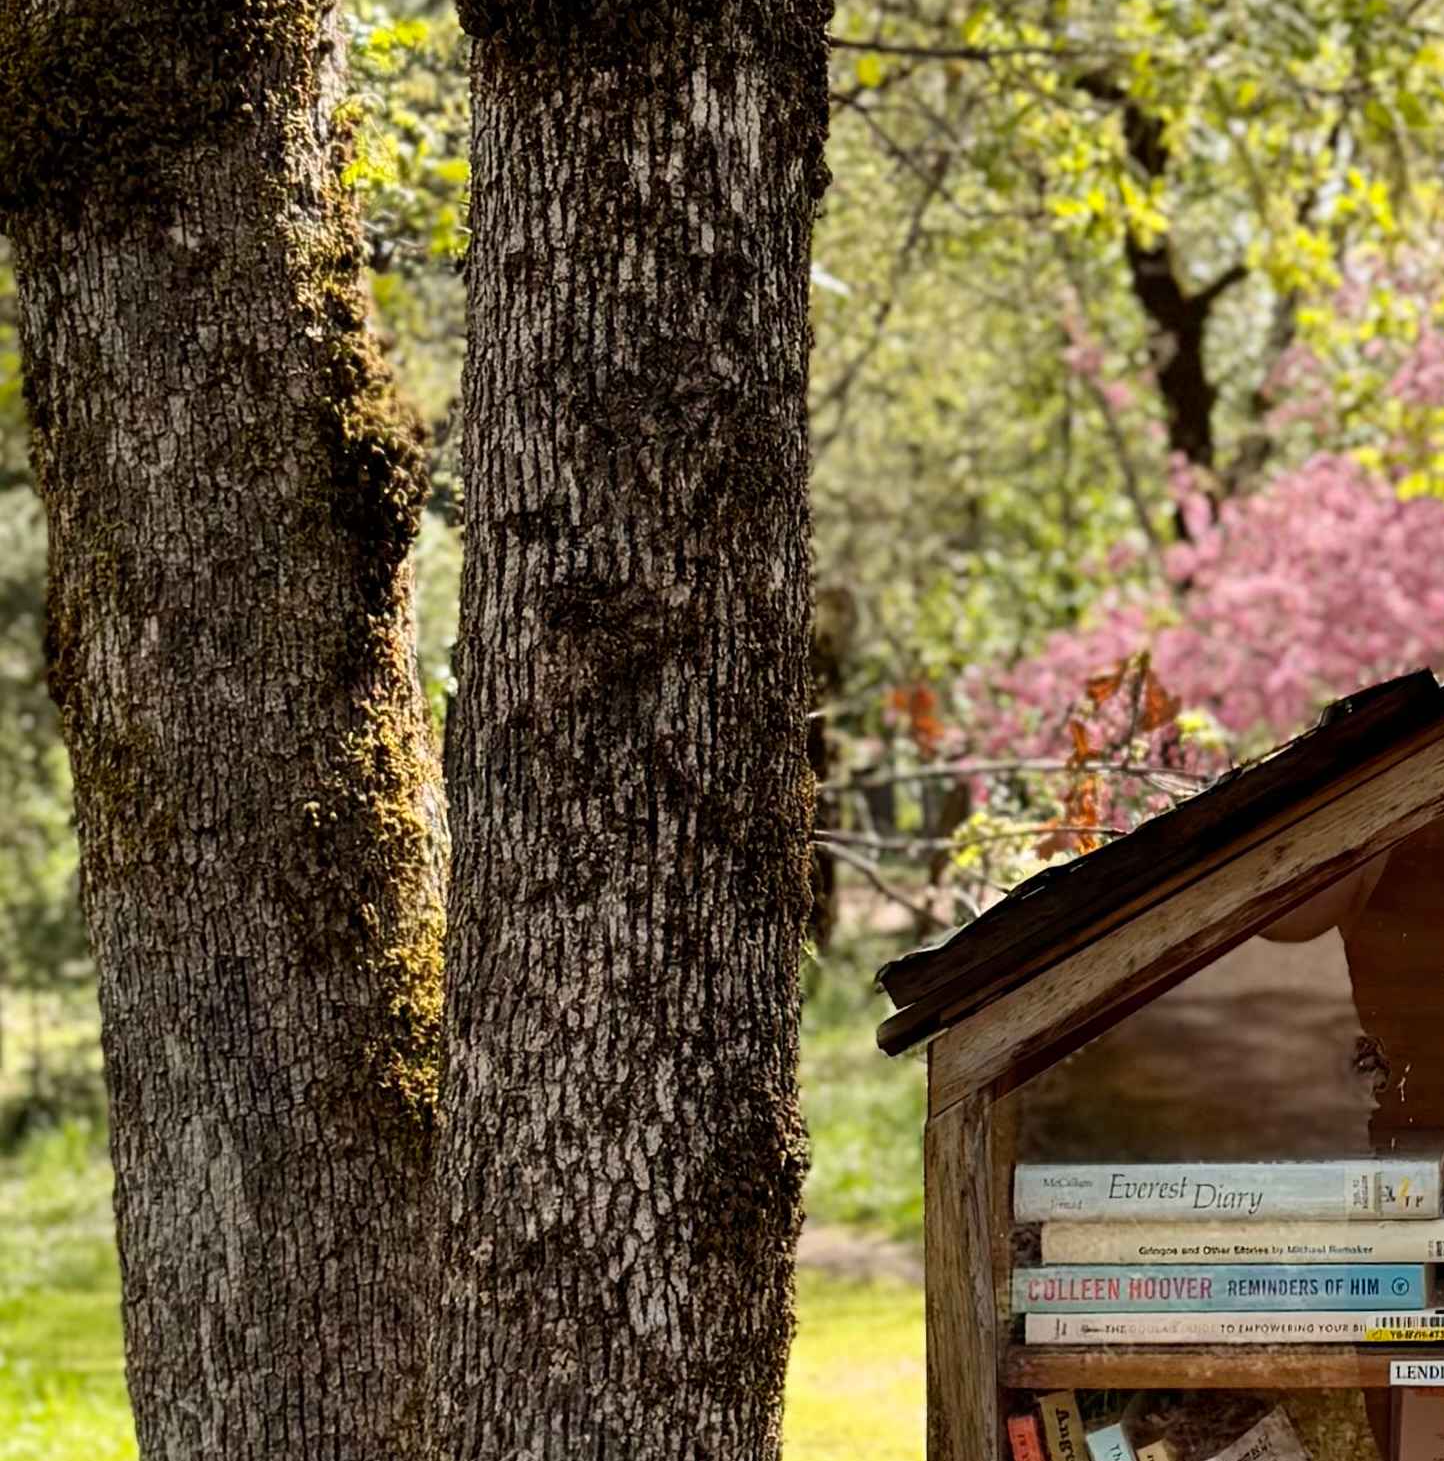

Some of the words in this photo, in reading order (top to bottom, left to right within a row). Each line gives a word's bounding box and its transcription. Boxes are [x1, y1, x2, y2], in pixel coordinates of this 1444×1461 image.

[1108, 1173, 1187, 1200] Everest
[1192, 1183, 1264, 1214] Diary
[1181, 1245, 1200, 1256] and
[1203, 1245, 1230, 1256] Other
[1271, 1246, 1284, 1258] by
[1027, 1277, 1120, 1302] COLLEEN
[1128, 1277, 1213, 1301] HOOVER
[1227, 1278, 1319, 1297] REMINDERS
[1325, 1278, 1344, 1296] OF
[1350, 1277, 1380, 1296] HIM
[1220, 1323, 1236, 1334] TO
[1238, 1323, 1314, 1334] EMPOWERING
[1318, 1323, 1349, 1334] YOUR
